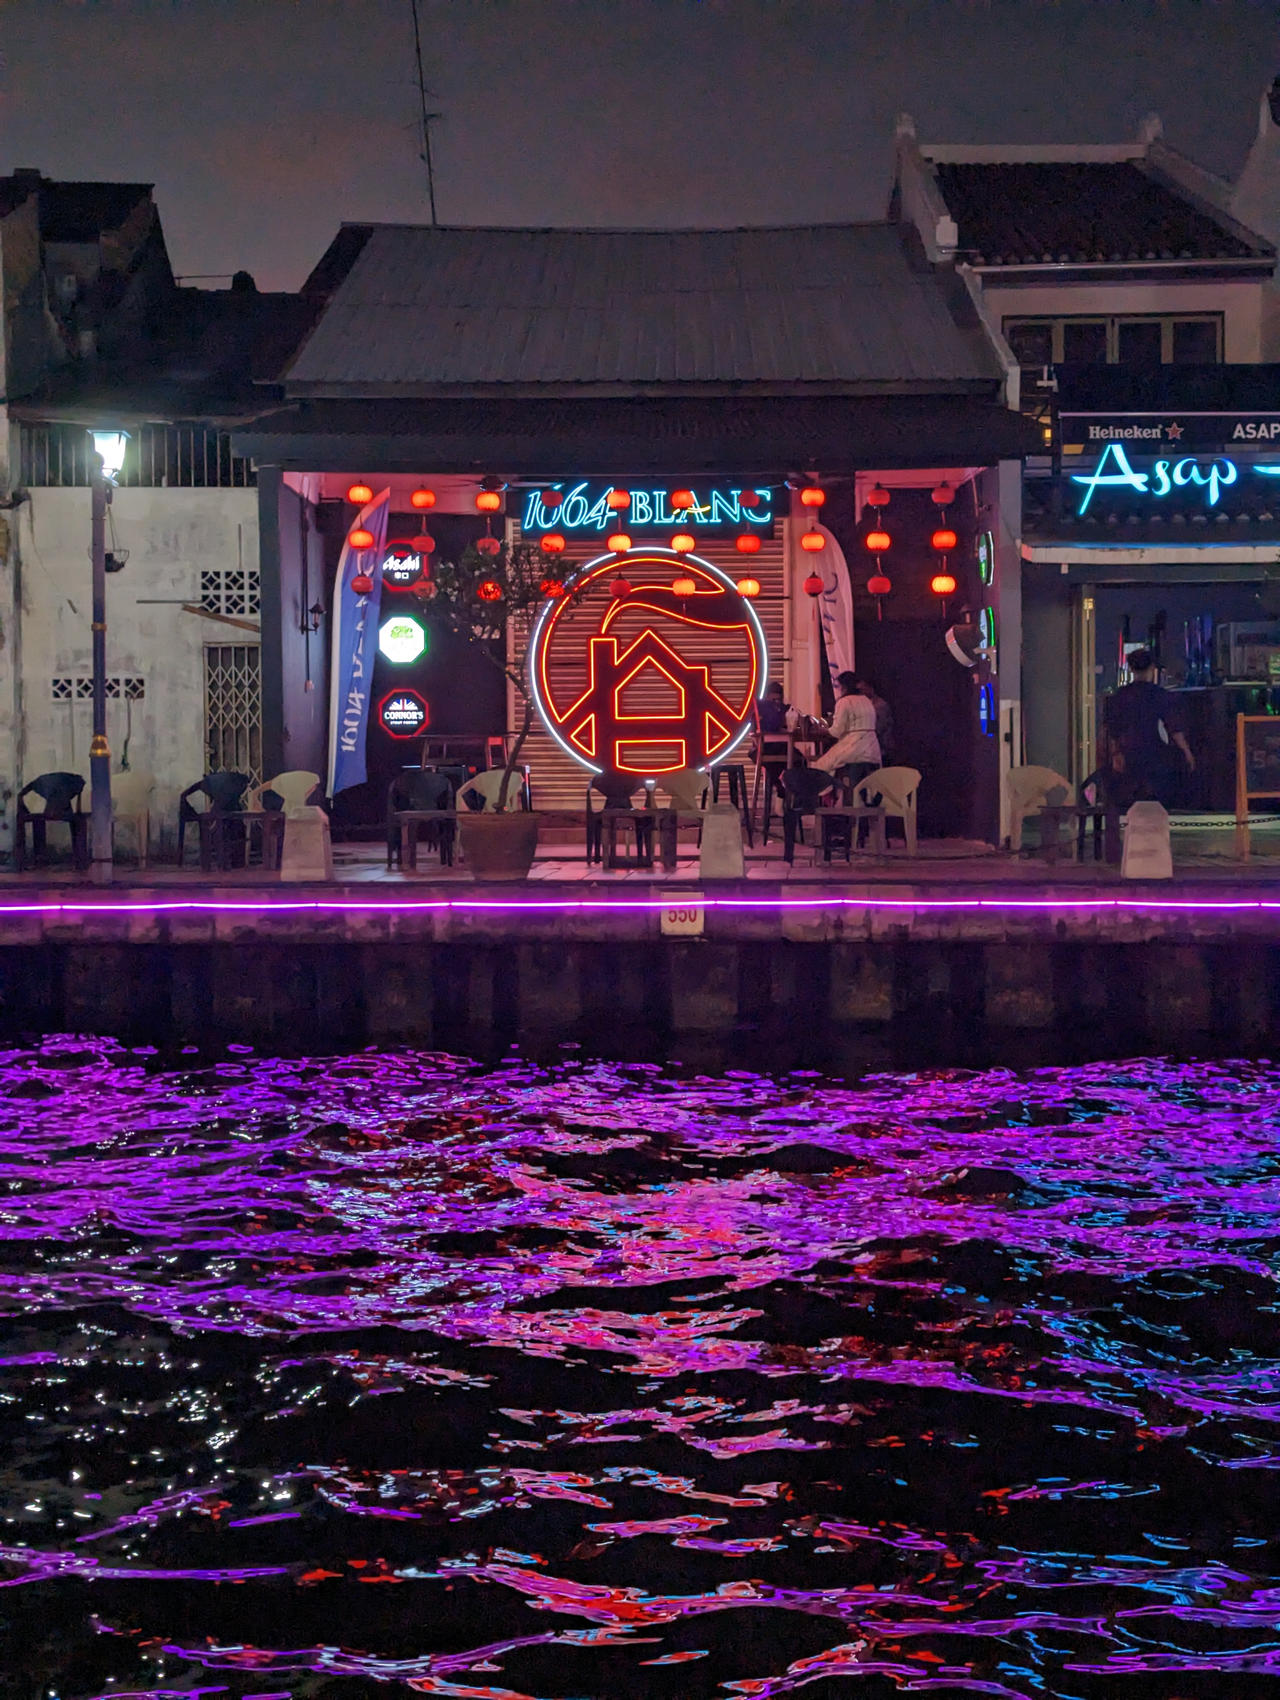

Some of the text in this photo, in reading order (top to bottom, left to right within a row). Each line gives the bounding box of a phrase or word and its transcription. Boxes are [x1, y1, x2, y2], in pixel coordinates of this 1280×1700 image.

[1088, 424, 1161, 439] Heineken
[1232, 423, 1280, 439] ASAP
[1071, 444, 1237, 515] Asap
[629, 489, 771, 524] BLANC
[382, 554, 420, 571] Asahi
[384, 711, 424, 720] CONNOR'S
